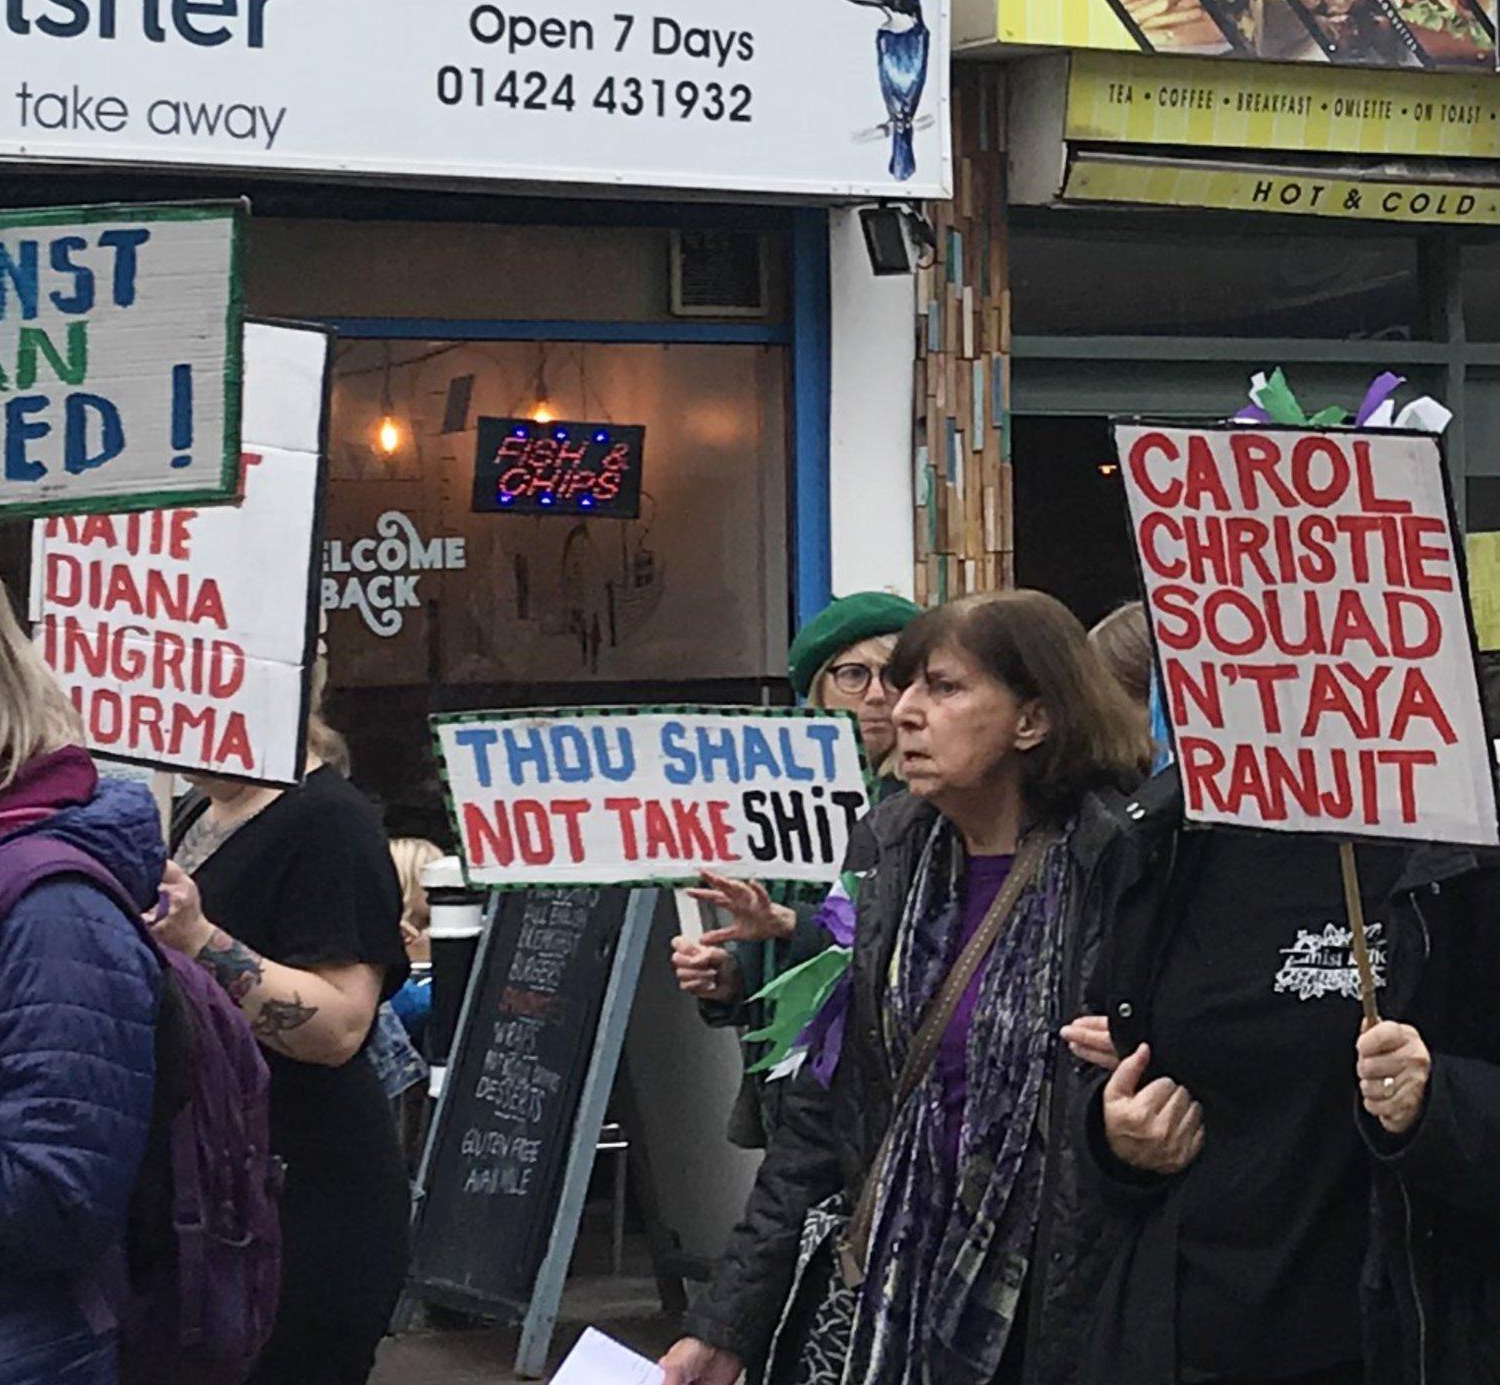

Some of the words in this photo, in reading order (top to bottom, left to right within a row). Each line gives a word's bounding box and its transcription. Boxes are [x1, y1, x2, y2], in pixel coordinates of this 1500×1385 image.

[468, 3, 594, 56] Open
[612, 14, 636, 53] 7
[651, 17, 754, 63] Days
[17, 81, 128, 133] take
[146, 95, 287, 150] away
[437, 65, 576, 112] 01424
[592, 76, 753, 124] 431932
[1109, 84, 1133, 105] TEA
[1158, 87, 1214, 110] COFFEE
[1236, 92, 1313, 117] BREAKFAST
[1414, 102, 1433, 122] ON
[1441, 105, 1481, 125] TOAST
[1251, 180, 1325, 208] HOT
[1343, 188, 1363, 210] &
[1381, 192, 1478, 214] COLD
[494, 435, 590, 468] FISH
[601, 442, 631, 471] &
[499, 467, 621, 500] CHIPS
[1128, 431, 1413, 515] CAROL
[1138, 511, 1453, 593] CHRISTIE
[46, 552, 229, 631] DIANA
[1151, 583, 1443, 659] SOUAD
[43, 613, 245, 699] INGRID
[454, 724, 636, 788] THOU
[661, 721, 840, 785] SHALT
[1179, 737, 1438, 826] RANJIT
[463, 798, 592, 868] NOT
[605, 796, 743, 862] TAKE
